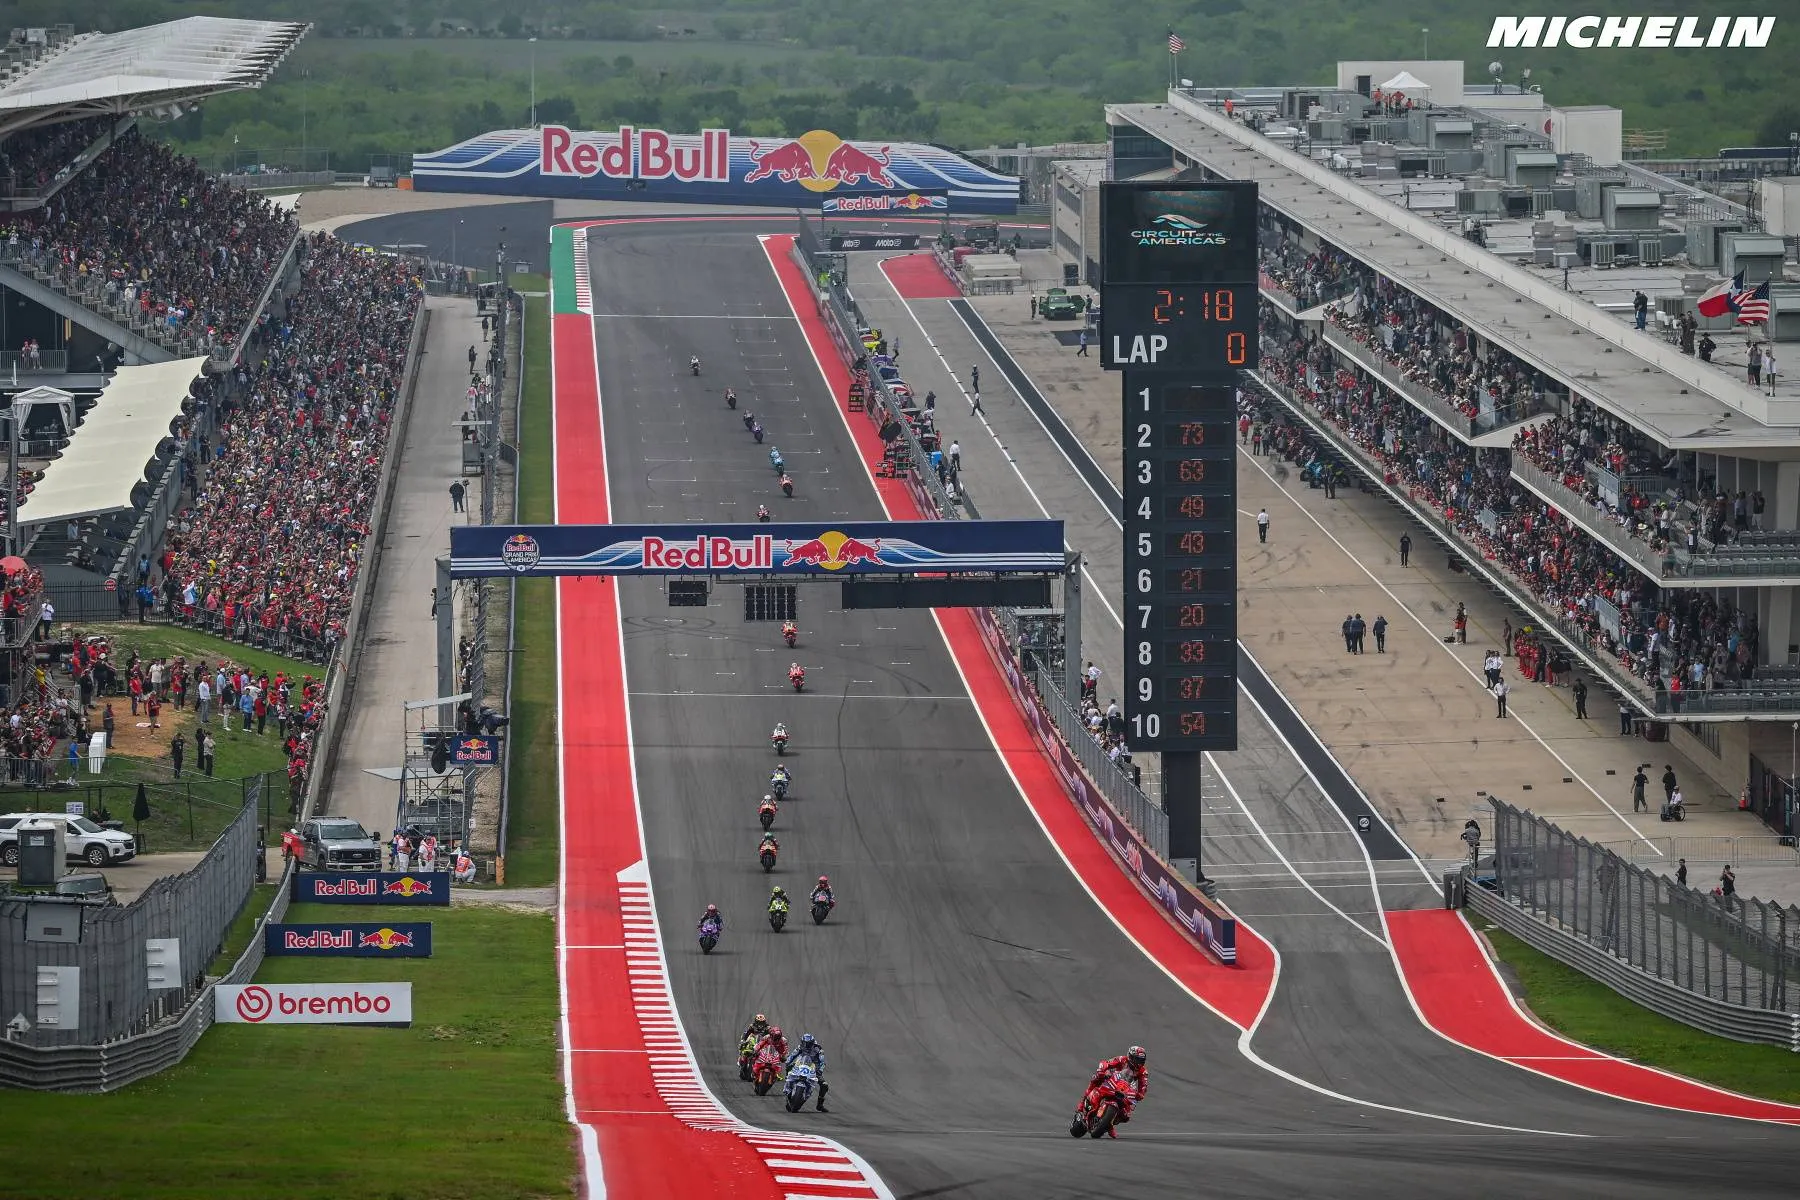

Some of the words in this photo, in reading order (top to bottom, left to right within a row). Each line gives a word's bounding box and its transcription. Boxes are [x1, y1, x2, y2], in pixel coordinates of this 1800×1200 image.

[542, 126, 632, 177] Red
[640, 130, 729, 179] Bull
[837, 196, 863, 210] Red
[864, 195, 889, 210] Bull
[1130, 230, 1197, 238] CIRCUIT
[1154, 290, 1233, 321] 2:18
[1113, 334, 1168, 364] LAP
[1227, 332, 1245, 364] 0
[1139, 388, 1150, 411] 1
[1138, 424, 1152, 448] 2
[1180, 424, 1204, 445] 73
[1138, 460, 1152, 484] 3
[1180, 461, 1204, 481] 63
[1138, 497, 1152, 520] 4
[1180, 496, 1204, 517] 49
[506, 543, 521, 551] Red
[521, 543, 535, 551] Bull
[643, 535, 706, 568] Red
[710, 535, 772, 568] Bull
[1138, 533, 1152, 557] 5
[1180, 533, 1204, 553] 43
[1138, 569, 1152, 593] 6
[1138, 605, 1152, 629] 7
[1180, 605, 1204, 626] 20
[1138, 642, 1152, 666] 8
[1180, 642, 1204, 662] 33
[1138, 678, 1153, 702] 9
[1131, 714, 1160, 738] 10
[456, 750, 474, 760] Red
[475, 750, 492, 760] Bull
[315, 879, 346, 895] Red
[347, 878, 377, 895] Bull
[285, 931, 319, 948] Red
[319, 930, 353, 948] Bull
[279, 991, 391, 1015] brembo
